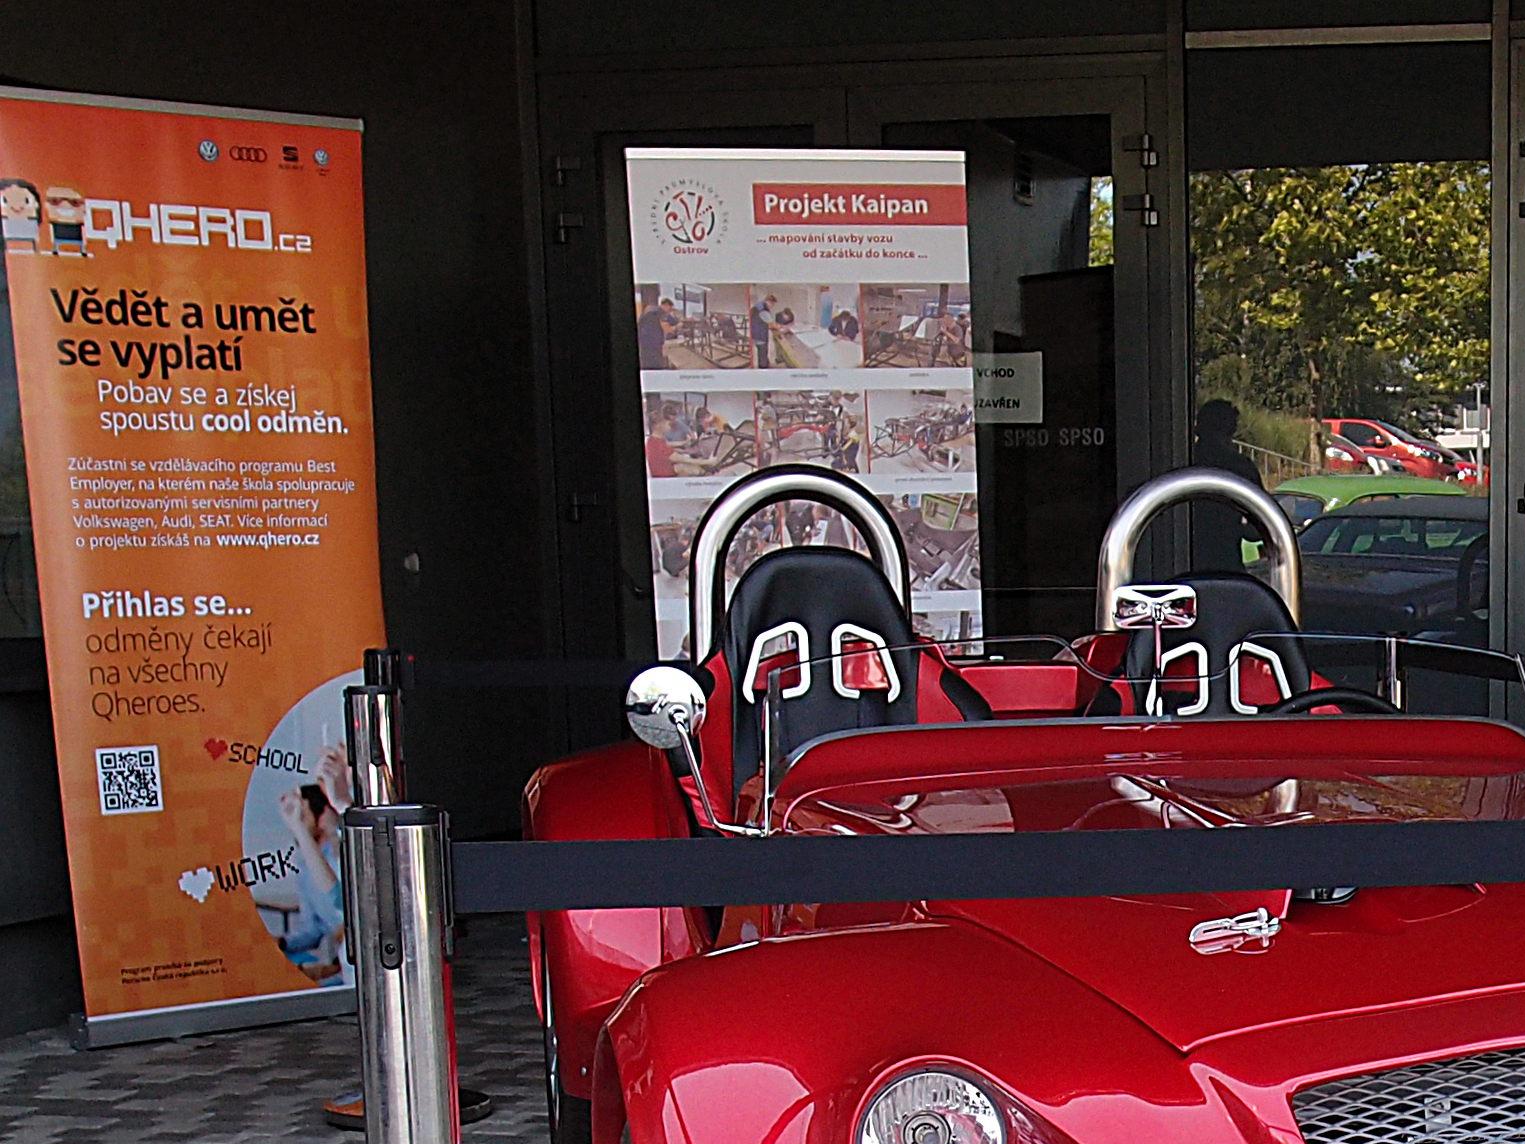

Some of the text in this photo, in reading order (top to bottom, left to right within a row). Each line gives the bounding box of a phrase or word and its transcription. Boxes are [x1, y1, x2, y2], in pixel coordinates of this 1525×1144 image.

[764, 193, 929, 219] Projekt Kaipan
[673, 246, 709, 255] Ostrov
[768, 233, 825, 246] mapování
[827, 232, 864, 246] stavby
[866, 234, 894, 244] vozu
[803, 248, 817, 259] od
[819, 248, 863, 260] začátku
[865, 249, 880, 259] do
[883, 249, 916, 259] konce
[50, 286, 317, 335] Vědět a umět
[58, 334, 244, 380] se vyplatí
[976, 367, 1015, 379] VCHOD
[97, 379, 297, 413] Pobav se a získej
[100, 410, 349, 436] spoustu cool odměn.
[1003, 427, 1105, 447] SPSO SPSO
[67, 456, 337, 476] Zúčastni se vzdělávacího programu Best
[70, 476, 355, 494] Employer, na kterém naše škola spolupracuje
[72, 495, 319, 513] s autorizovanými servisními partnery
[73, 514, 328, 531] Volkswagen, Audi, SEAT. Více informací
[75, 532, 320, 550] o projektu získáš na www.qhero.cz
[81, 590, 251, 620] Přihlas se...
[85, 621, 273, 657] odměny čekají
[89, 655, 228, 688] na všechny
[91, 691, 206, 722] Qheroes.
[228, 742, 309, 774] SCHOOL
[215, 846, 300, 892] WORK
